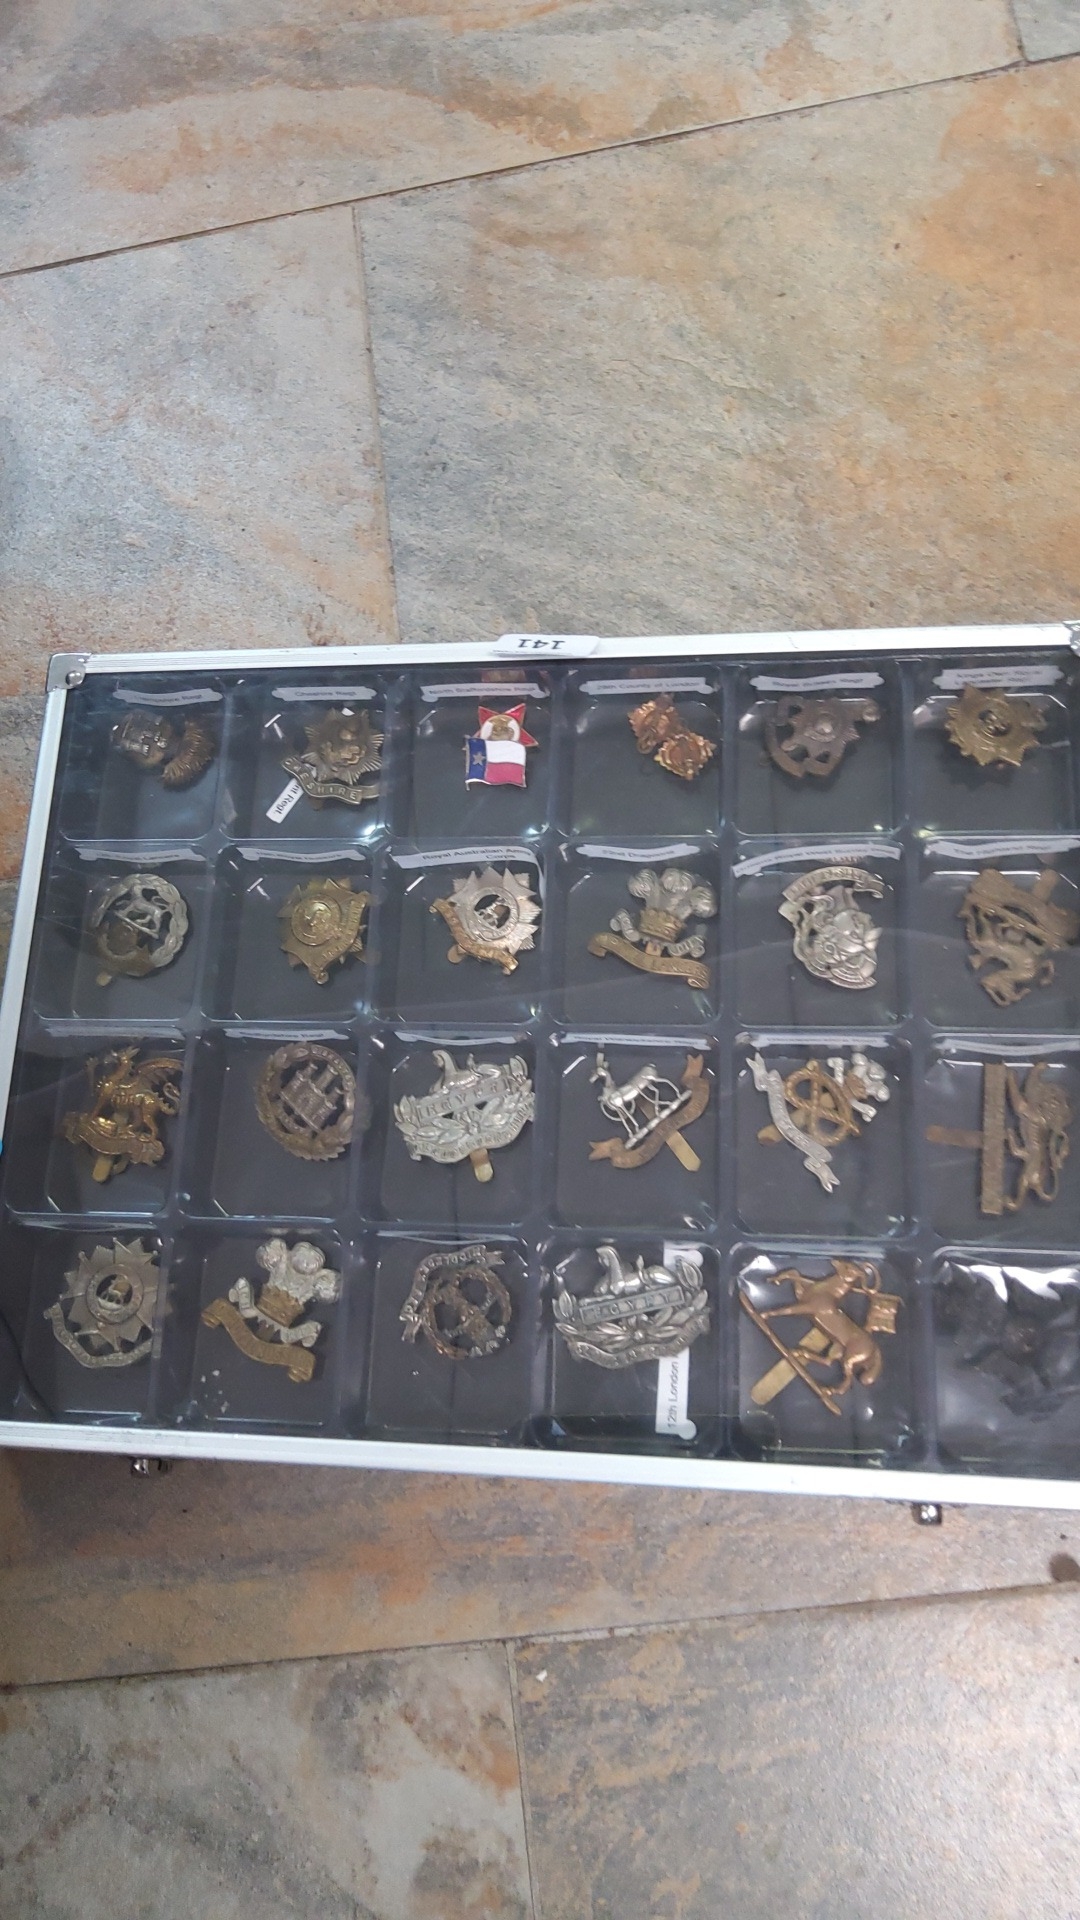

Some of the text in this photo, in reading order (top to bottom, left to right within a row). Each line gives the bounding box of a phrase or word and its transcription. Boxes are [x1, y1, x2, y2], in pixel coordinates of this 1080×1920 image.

[518, 639, 565, 649] 141
[422, 852, 451, 861] Royal
[454, 848, 503, 856] Australian
[667, 1361, 679, 1427] 12th London
